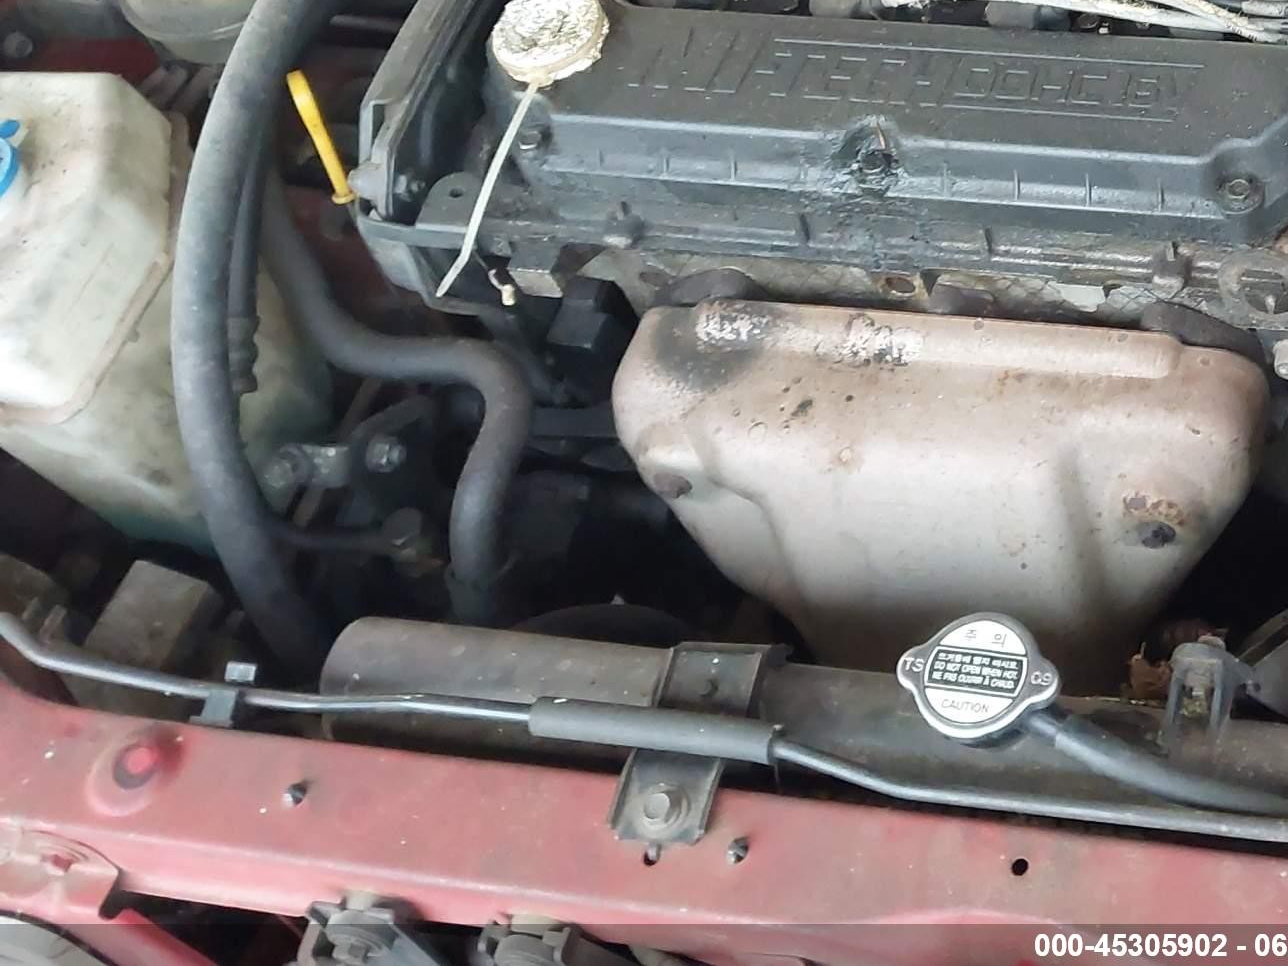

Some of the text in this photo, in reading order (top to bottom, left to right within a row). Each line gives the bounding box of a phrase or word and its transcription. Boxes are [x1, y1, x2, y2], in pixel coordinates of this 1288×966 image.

[903, 657, 926, 672] TS
[961, 664, 981, 676] OPEN
[940, 698, 991, 714] CAUTION
